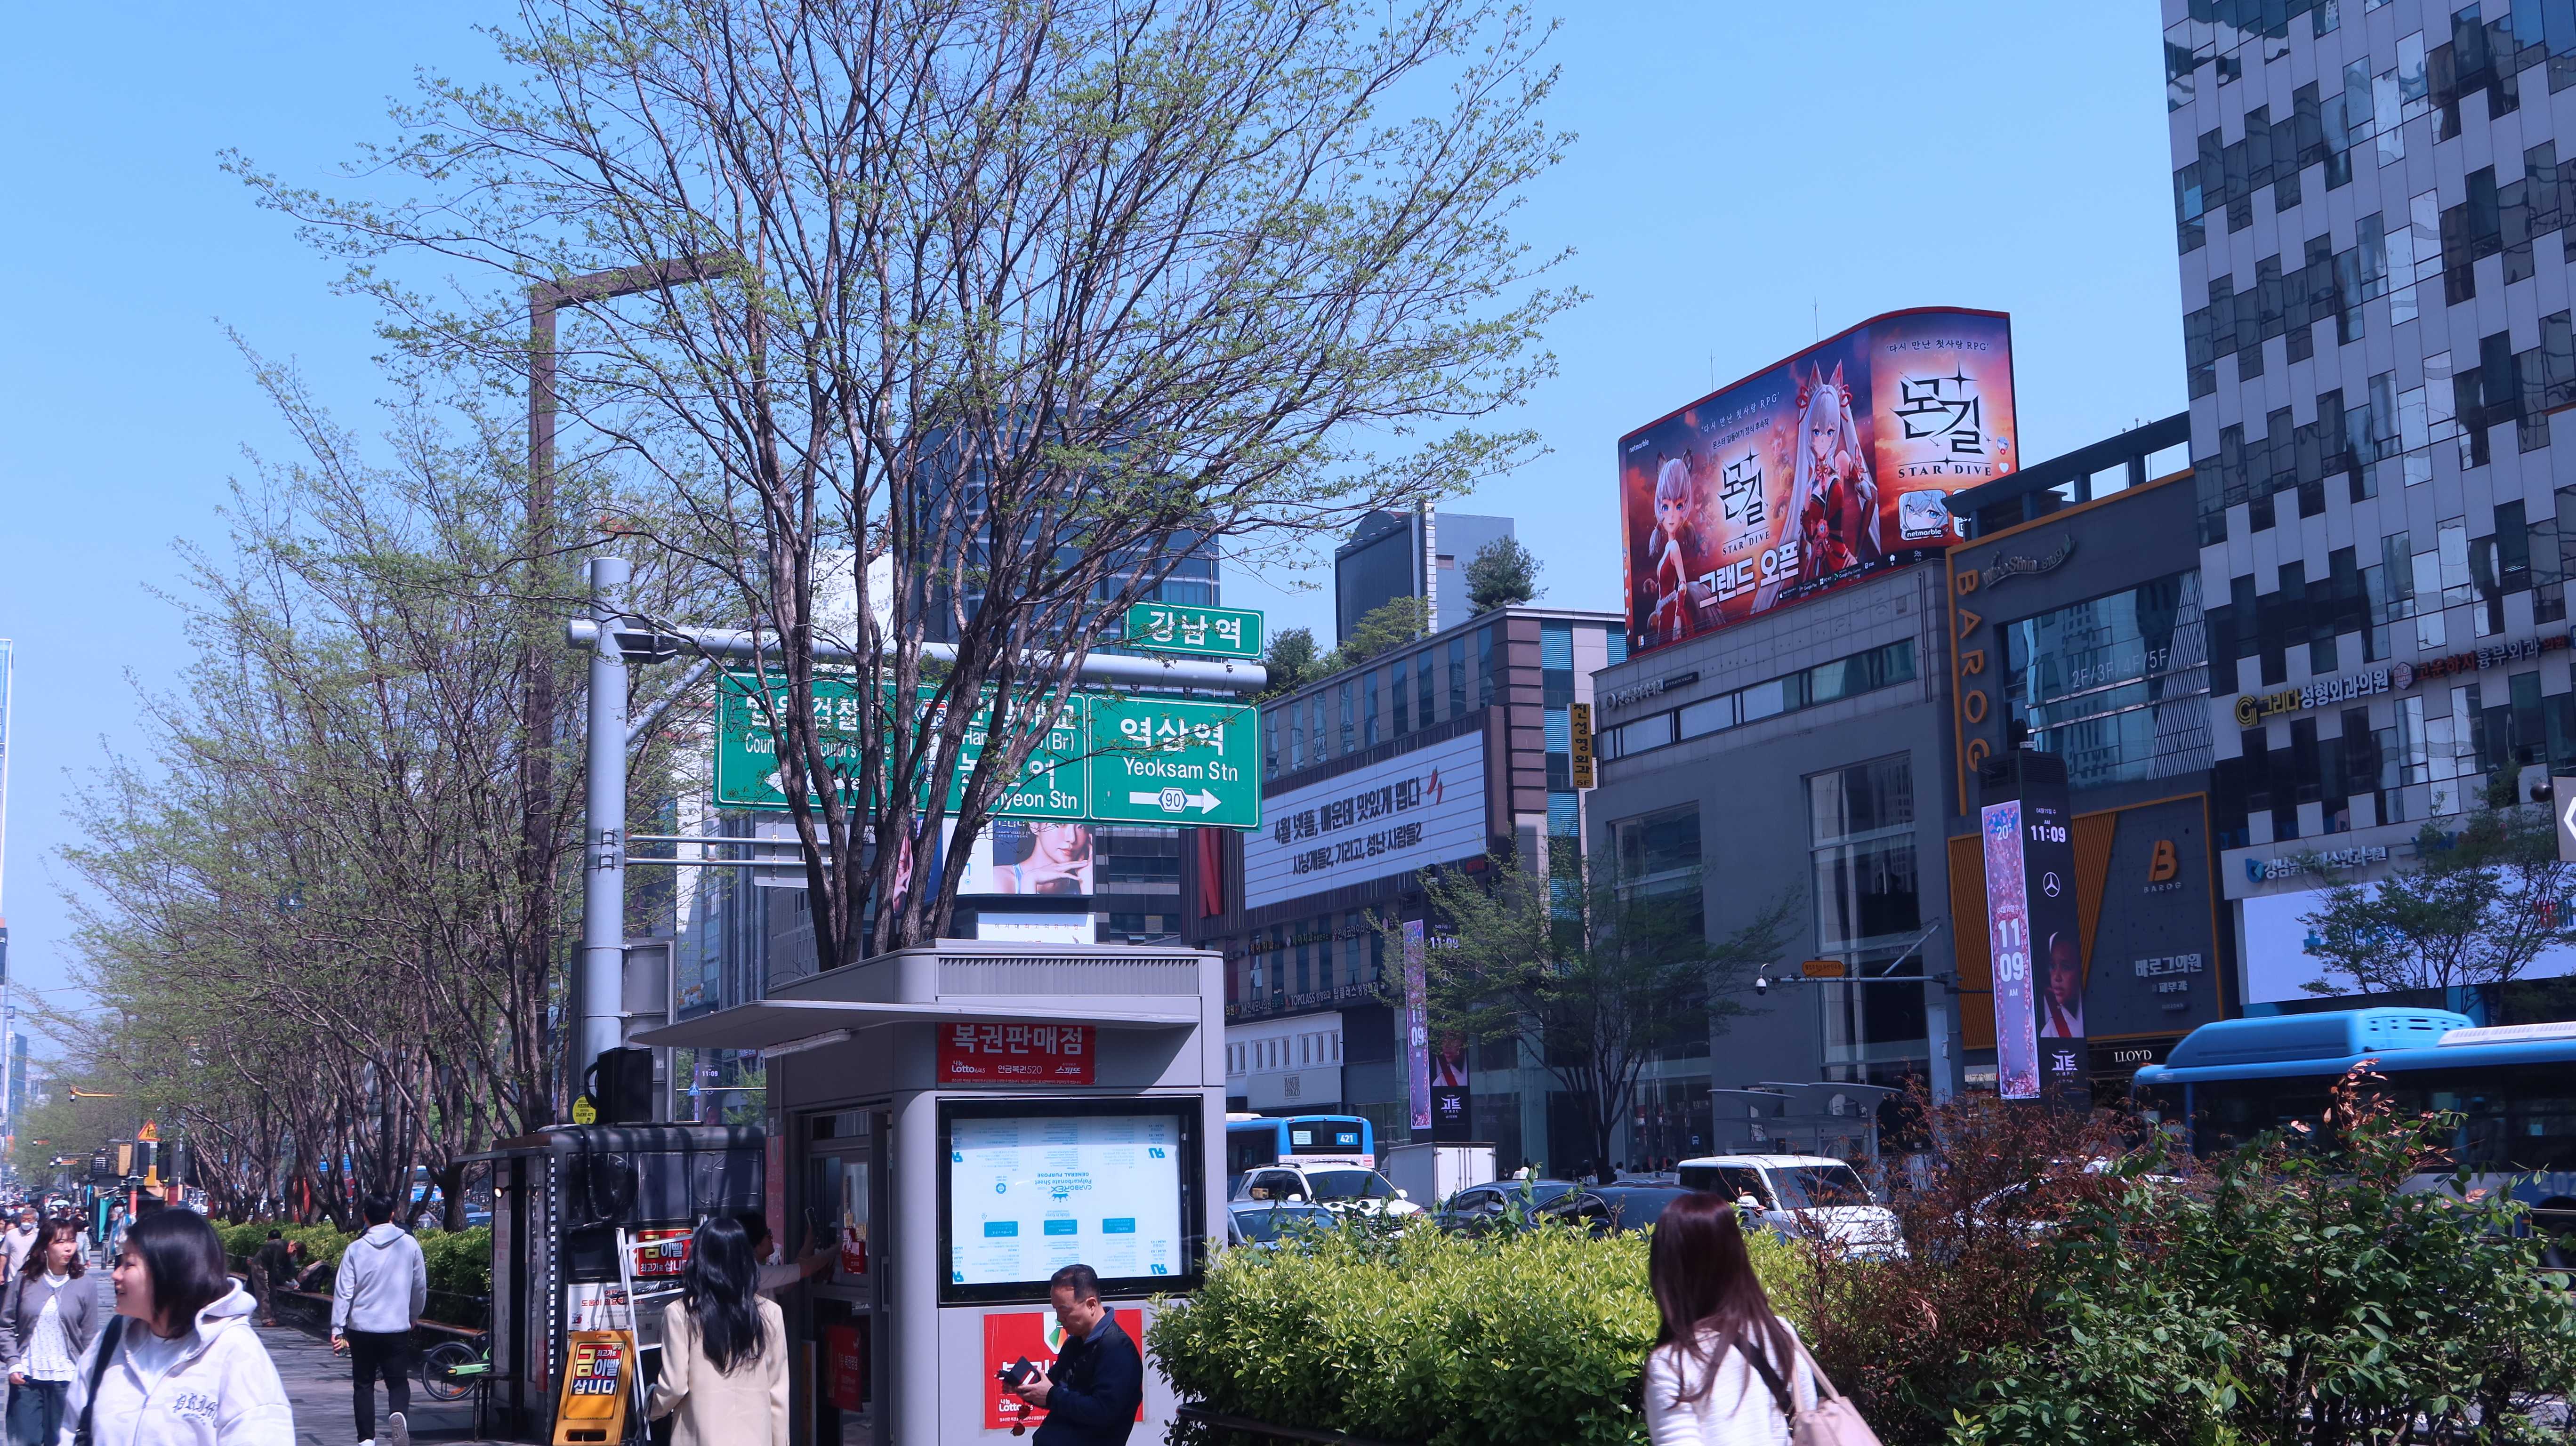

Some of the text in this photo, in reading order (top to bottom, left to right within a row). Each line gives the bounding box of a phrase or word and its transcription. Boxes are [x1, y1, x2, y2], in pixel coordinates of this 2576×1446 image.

[1912, 340, 1931, 350] 만난
[1936, 339, 1964, 350] 첫사랑
[1720, 413, 1732, 427] 만난
[1736, 402, 1756, 421] 첫사랑
[1713, 418, 1770, 450] 몬스터 길들이기 정식 후속작
[1629, 438, 1649, 454] netmarble
[1899, 466, 1992, 478] STAR DIVE
[1907, 529, 1942, 538] netmarble
[1722, 531, 1770, 556] STAR DIVE
[1699, 540, 1799, 609] 그랜드 오픈
[1148, 611, 1241, 649] 강남역
[1120, 717, 1224, 756] 역삼역
[1123, 757, 1239, 781] Yeoksam Stn
[1049, 790, 1078, 810] Stn
[1165, 793, 1181, 807] 90
[1274, 776, 1422, 844] 4월 넷플, 매운데 맛있게 맵다
[2030, 825, 2066, 843] 11:09
[1293, 821, 1422, 875] 사냥개들2, 기리고, 성난 사람들2
[2143, 882, 2182, 893] BAROG
[1997, 918, 2021, 948] 11
[1999, 952, 2024, 983] 09
[2134, 953, 2203, 978] 바로그의원
[1291, 993, 1316, 1007] TOPCLASS
[2009, 989, 2018, 997] AM
[952, 1024, 1082, 1055] 복권판매점
[1411, 1026, 1424, 1048] 09
[2114, 1050, 2152, 1062] LLOYD
[951, 1065, 975, 1073] Lotto
[998, 1065, 1043, 1075] 연금복권520
[1055, 1066, 1081, 1075] 스피또
[1340, 1134, 1353, 1143] 421
[1051, 1185, 1092, 1193] CARBOREX
[640, 1262, 663, 1272] 최고가로
[581, 1299, 602, 1307] 도움이
[573, 1379, 615, 1395] 삽니다
